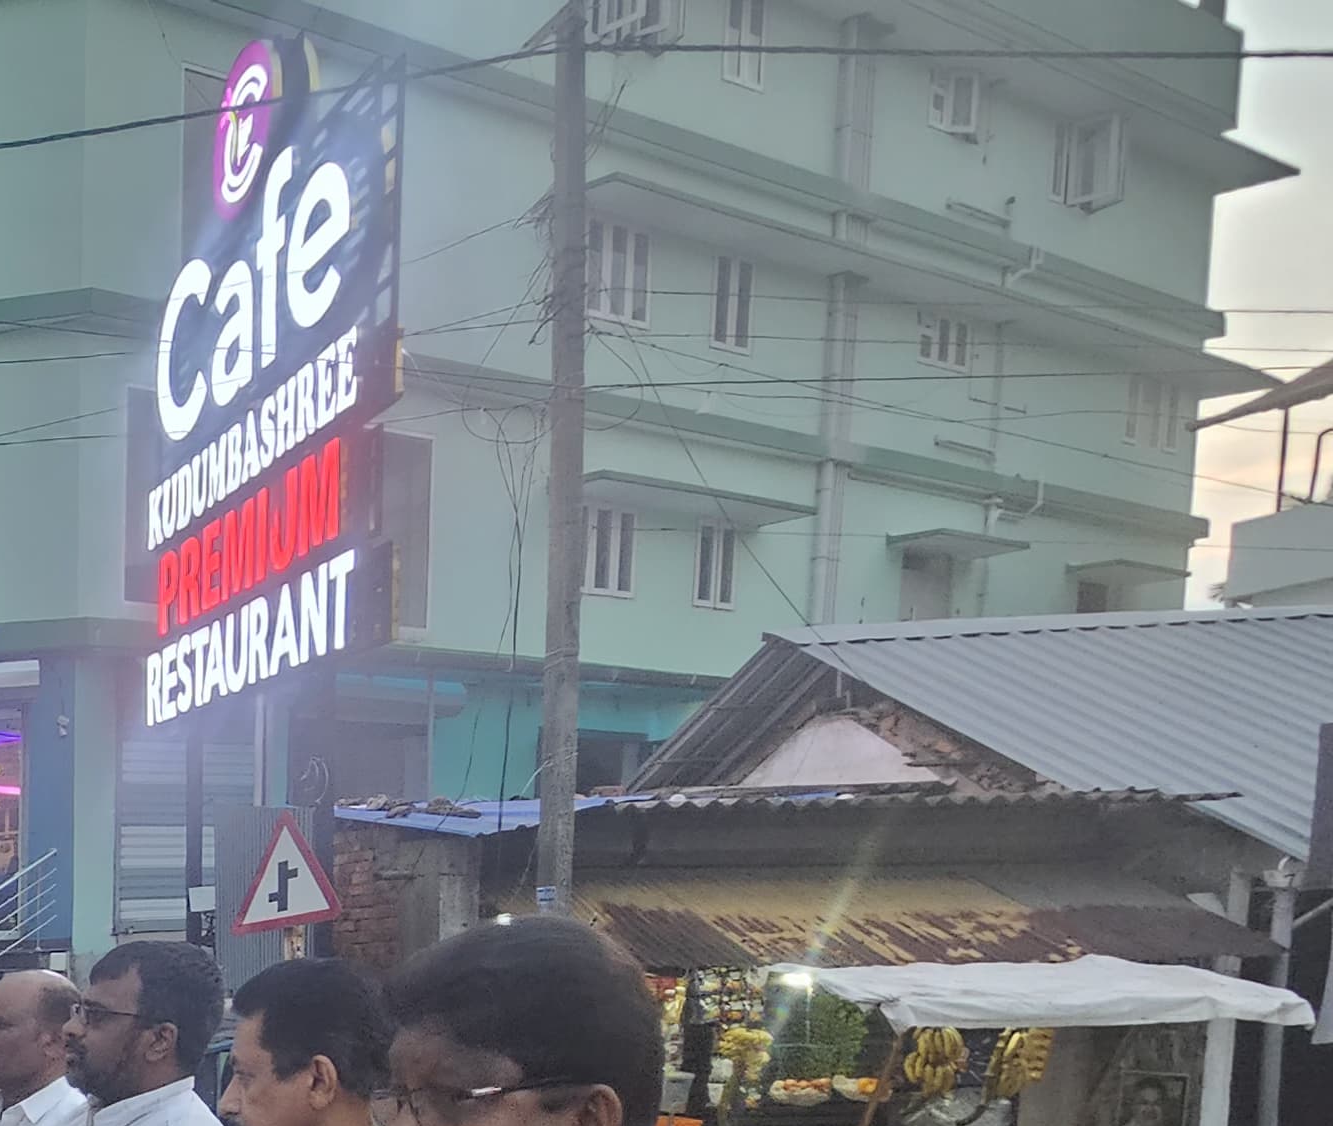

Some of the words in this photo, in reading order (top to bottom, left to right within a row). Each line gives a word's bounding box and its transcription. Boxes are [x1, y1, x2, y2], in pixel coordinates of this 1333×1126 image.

[156, 145, 351, 441] Cafe
[147, 324, 359, 550] KUDUMBASHREE
[157, 437, 340, 636] PREMIUM
[146, 547, 356, 728] RESTAURANT
